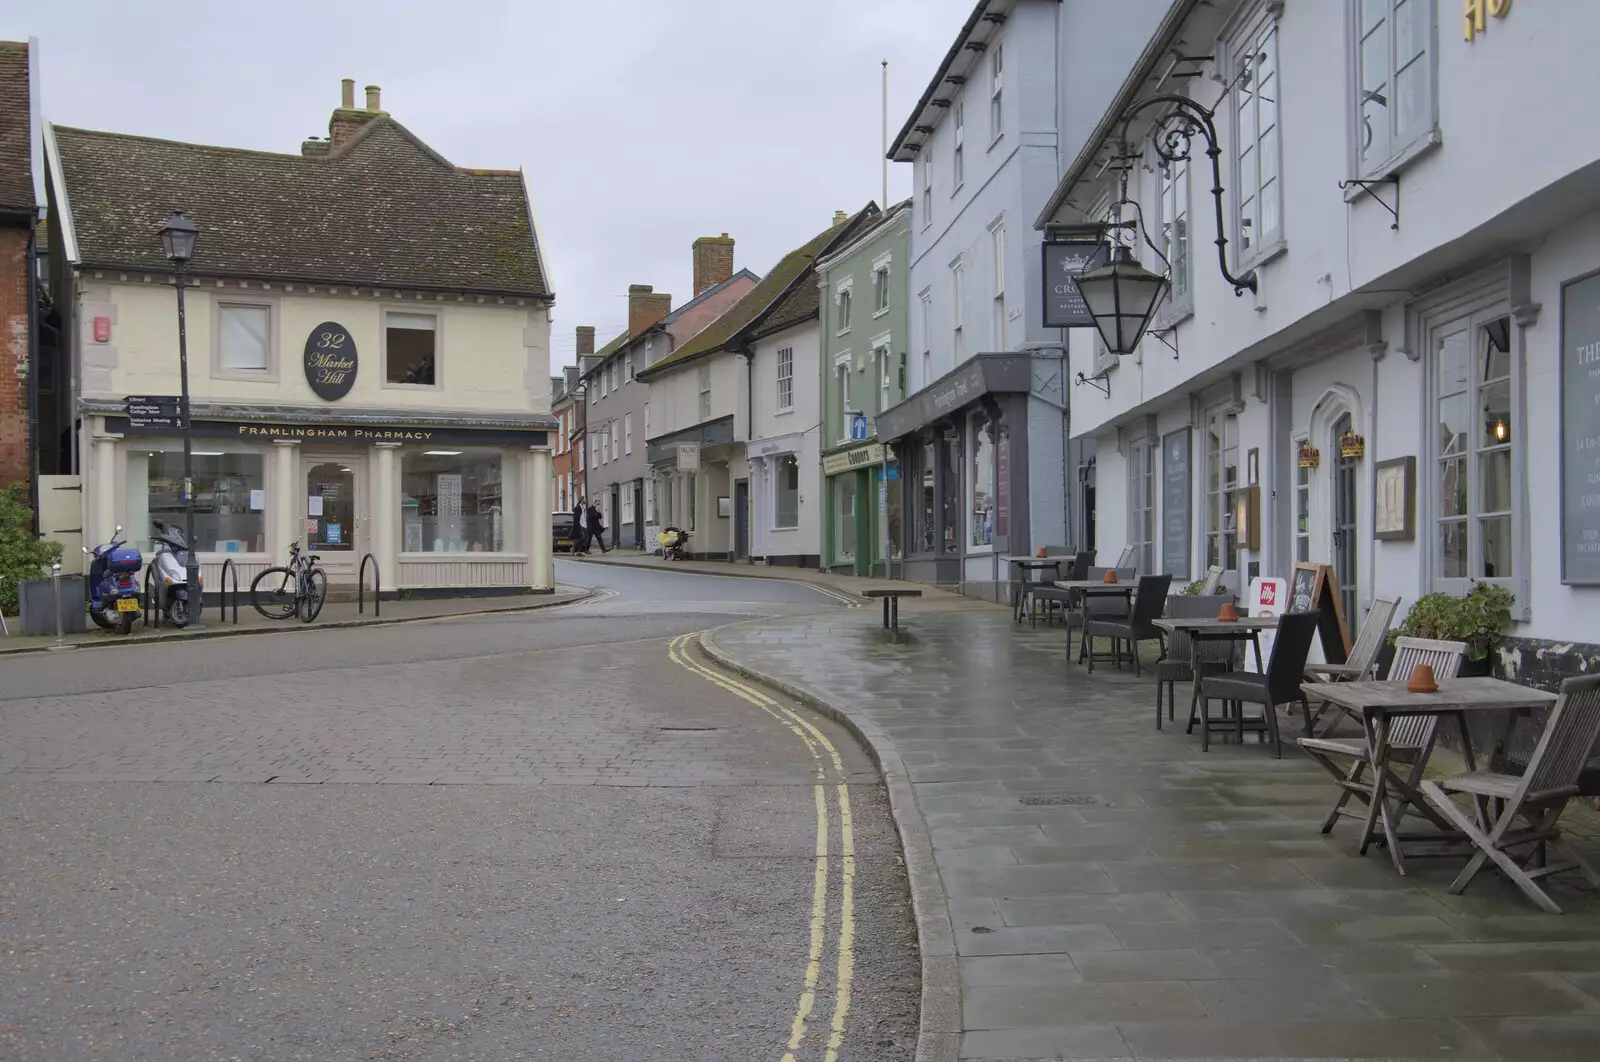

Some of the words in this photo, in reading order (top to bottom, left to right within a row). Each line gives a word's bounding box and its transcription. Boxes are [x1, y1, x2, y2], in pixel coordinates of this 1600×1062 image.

[316, 332, 346, 349] 32
[308, 352, 355, 369] Market
[316, 368, 352, 385] Hill
[239, 426, 348, 438] FRAMLINGHAM
[354, 429, 432, 440] PHARMACY
[1261, 585, 1275, 604] illy
